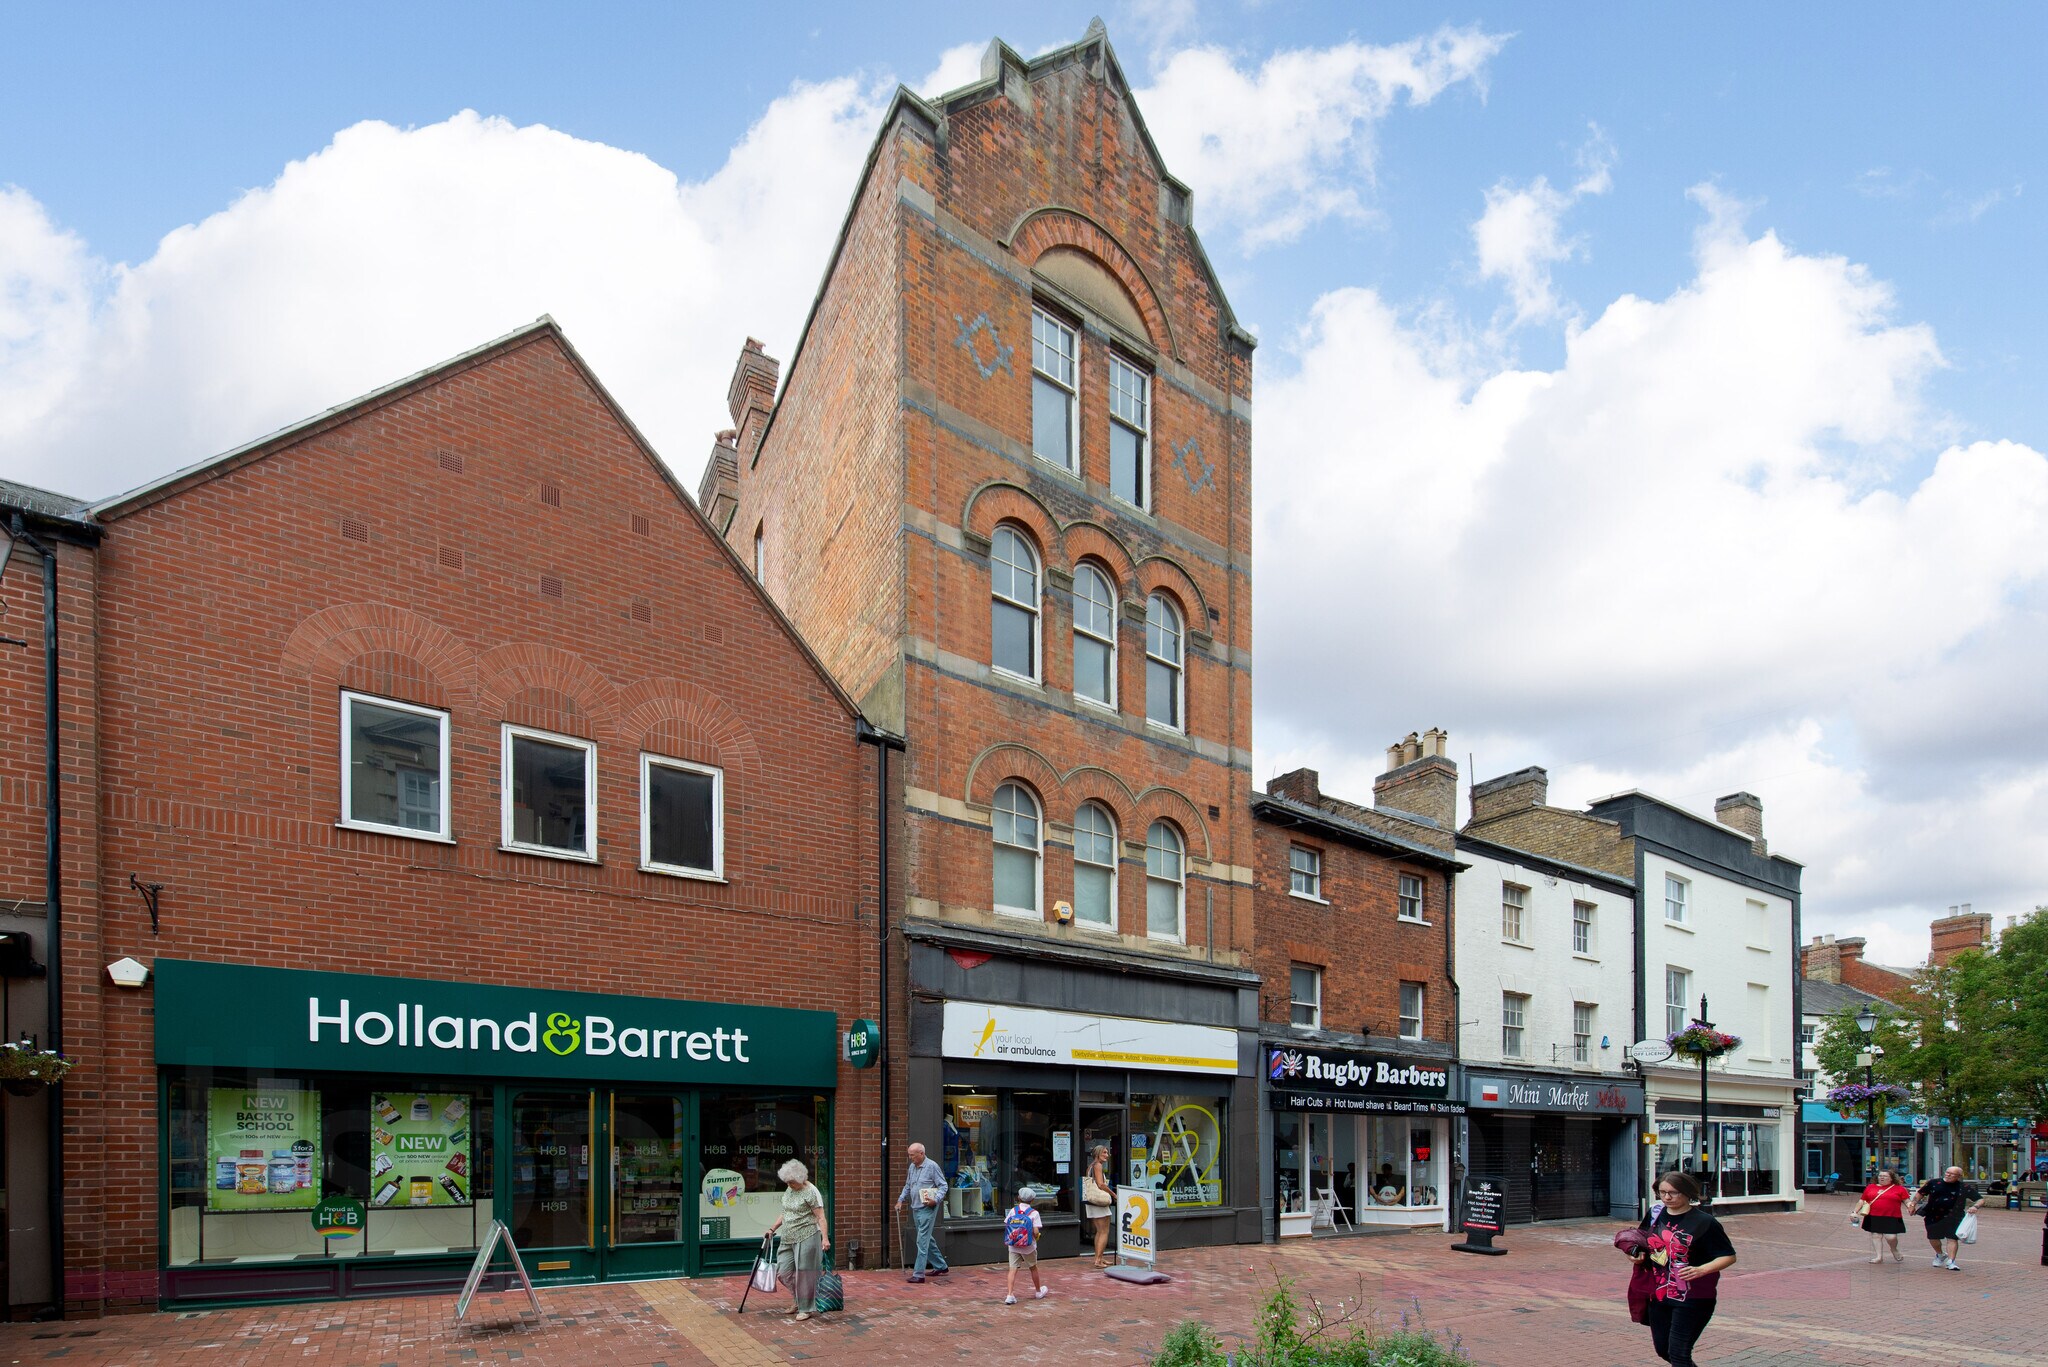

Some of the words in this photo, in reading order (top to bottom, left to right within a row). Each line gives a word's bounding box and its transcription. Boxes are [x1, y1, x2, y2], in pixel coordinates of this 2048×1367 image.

[850, 1032, 867, 1048] H&B
[995, 1035, 1012, 1044] your
[1014, 1034, 1033, 1045] local
[997, 1044, 1009, 1054] air
[1010, 1045, 1056, 1057] ambulance
[1306, 1055, 1372, 1087] Rugby
[1376, 1062, 1446, 1088] Barbers
[247, 1096, 284, 1108] NEW
[1509, 1084, 1541, 1104] Mini
[1548, 1086, 1589, 1111] Market
[1290, 1096, 1306, 1107] Hair
[1307, 1096, 1324, 1107] Cuts
[1334, 1098, 1346, 1108] Hot
[1347, 1099, 1365, 1109] towel
[1365, 1100, 1385, 1110] shave
[1394, 1101, 1412, 1111] Beard
[1412, 1102, 1429, 1112] Trims
[1437, 1103, 1450, 1112] Skin
[1450, 1104, 1466, 1114] fades
[236, 1112, 273, 1121] BACK
[275, 1112, 294, 1122] TO
[237, 1122, 294, 1131] SCHOOL
[400, 1136, 443, 1150] NEW
[540, 1146, 566, 1156] H&B
[706, 1176, 741, 1184] summer
[541, 1202, 568, 1212] H&B
[320, 1212, 358, 1226] H&B
[1122, 1234, 1150, 1248] SHOP
